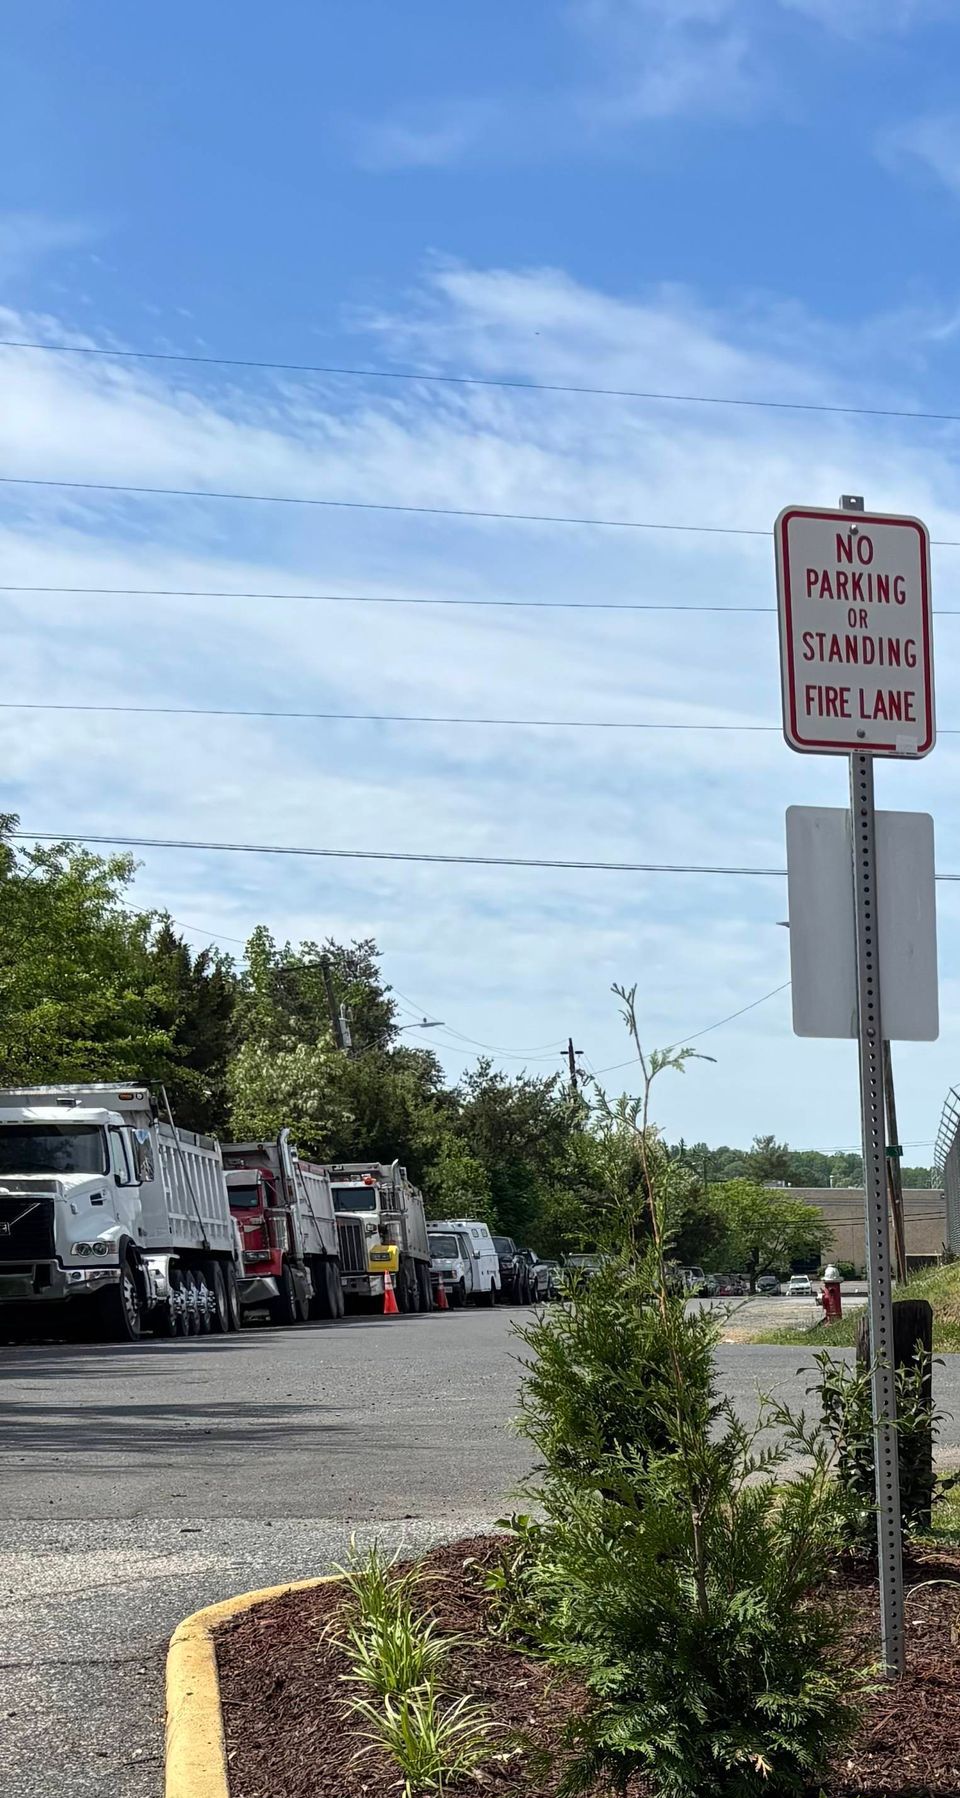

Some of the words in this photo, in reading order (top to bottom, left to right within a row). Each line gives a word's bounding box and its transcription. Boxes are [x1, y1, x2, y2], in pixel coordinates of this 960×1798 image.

[835, 533, 874, 565] NO
[805, 568, 906, 605] PARKING
[847, 607, 869, 629] OR
[802, 631, 917, 668] STANDING
[805, 684, 852, 719] FIRE
[859, 688, 917, 722] LANE
